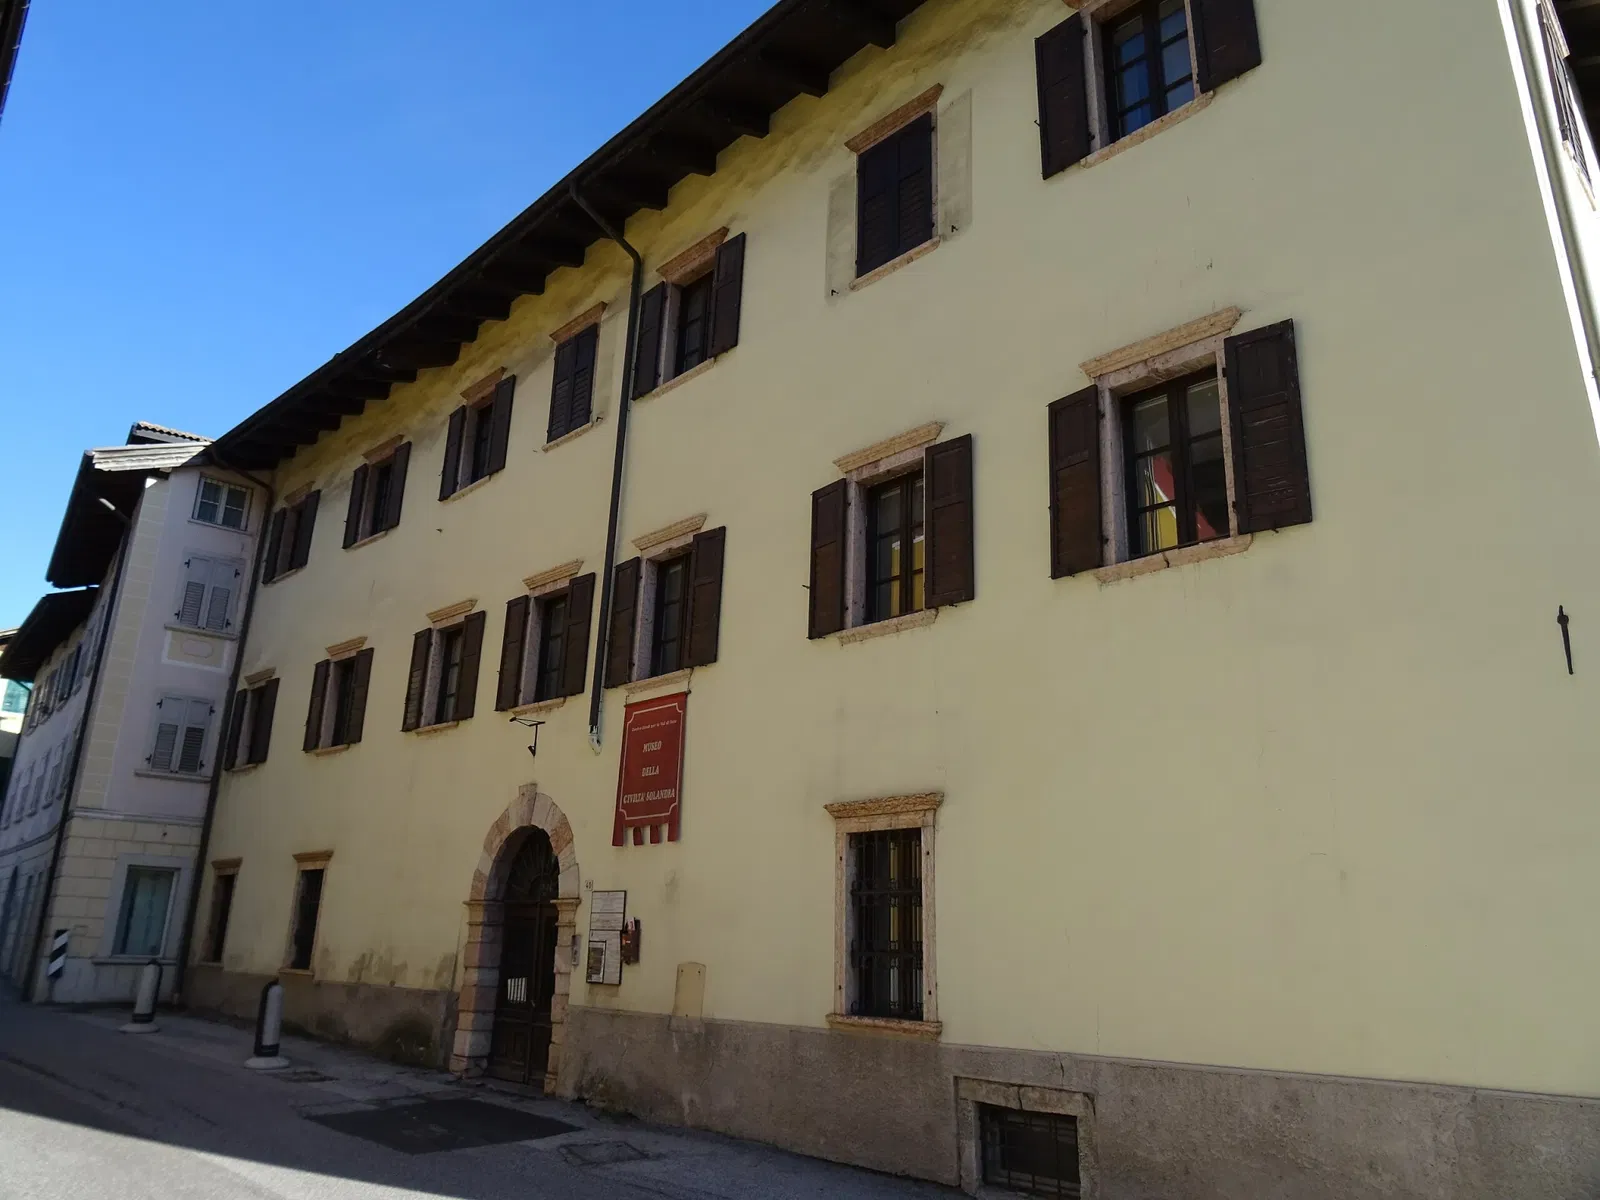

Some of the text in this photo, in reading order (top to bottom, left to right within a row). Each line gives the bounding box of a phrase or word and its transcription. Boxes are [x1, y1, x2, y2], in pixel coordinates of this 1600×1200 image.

[642, 740, 662, 752] MUSEO
[642, 766, 660, 777] DELLA
[646, 788, 675, 800] SOLANDRA
